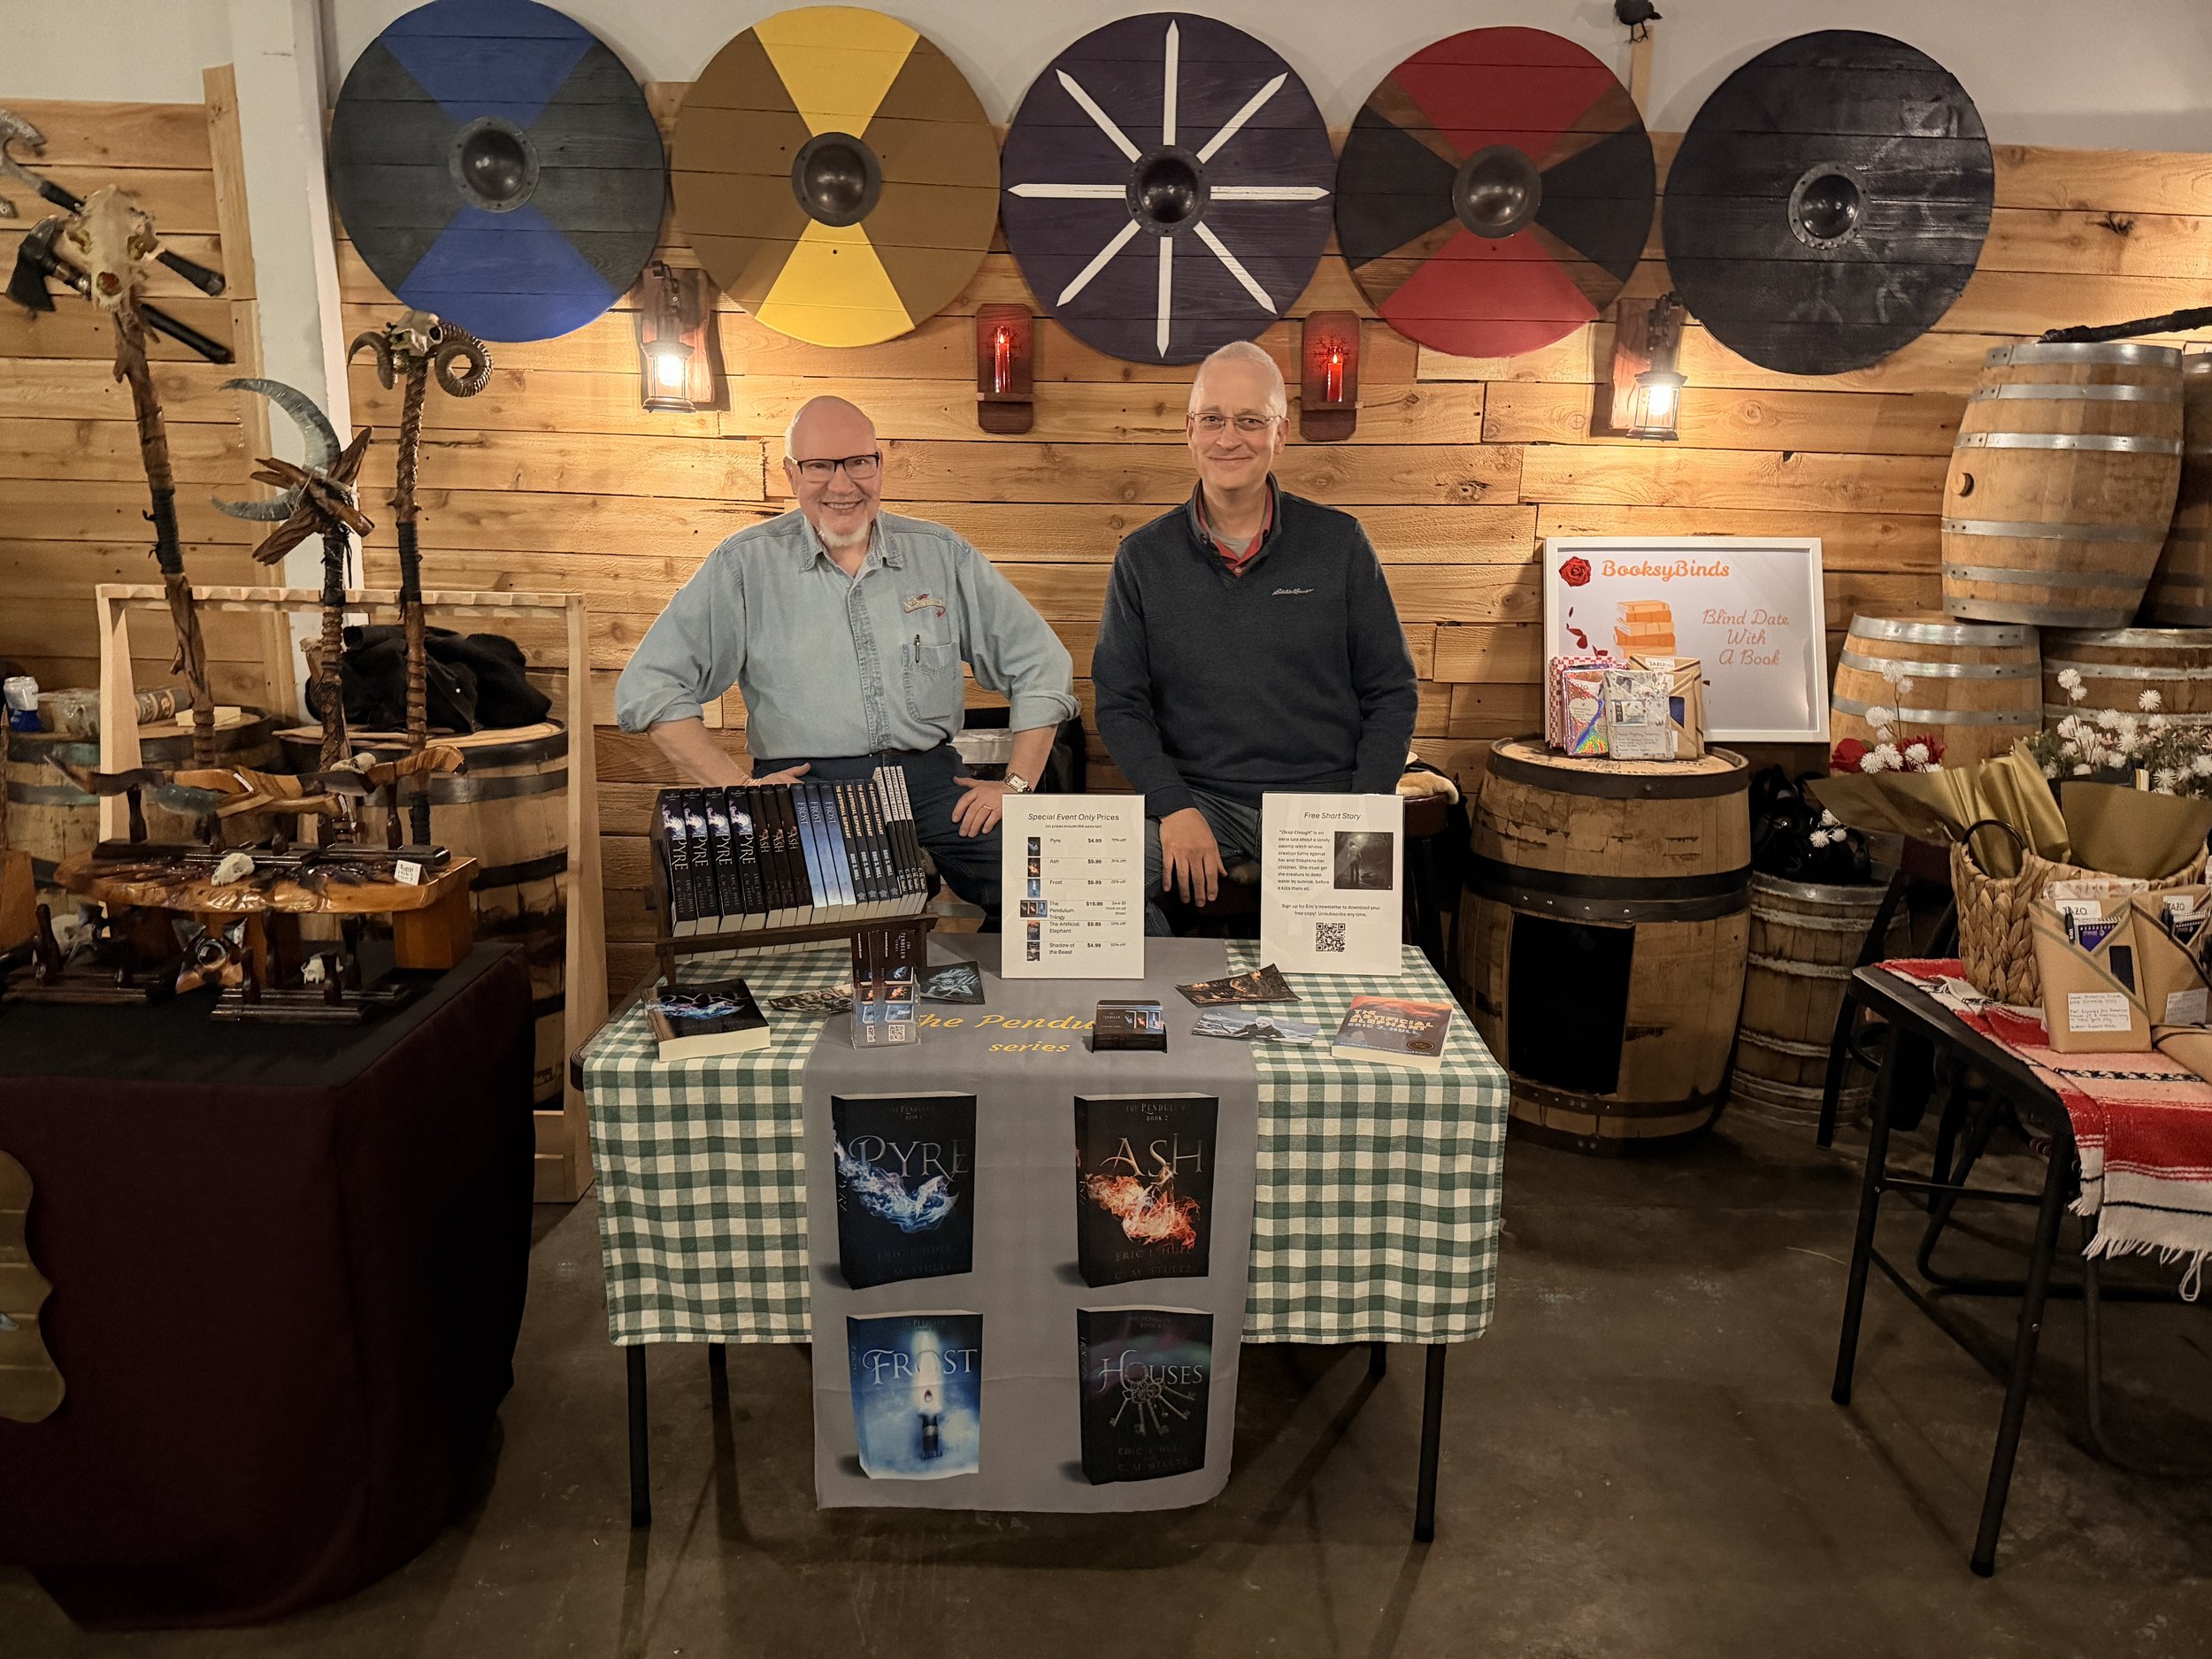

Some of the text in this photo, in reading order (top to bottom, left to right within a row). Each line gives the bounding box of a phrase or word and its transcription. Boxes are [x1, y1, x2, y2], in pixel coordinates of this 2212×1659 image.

[1602, 559, 1730, 582] BooksyBinds
[1702, 608, 1789, 625] Blind Date
[1727, 629, 1766, 645] With
[1719, 649, 1780, 666] A Book
[797, 802, 808, 825] FROST
[810, 801, 821, 823] FROST
[825, 801, 836, 823] FROST
[1028, 814, 1055, 823] Special
[1342, 812, 1361, 821] Story
[715, 833, 732, 865] PYRE
[739, 832, 756, 864] PYRE
[759, 834, 770, 853] ASH
[773, 835, 784, 853] ASH
[788, 831, 799, 849] ASH
[671, 837, 688, 870] PYRE
[692, 835, 708, 867] PYRE
[975, 1014, 1095, 1030] Pendu
[1350, 1018, 1427, 1031] ELEPHANT
[1351, 1014, 1434, 1028] ARTIFICIAL
[988, 1041, 1071, 1053] series
[849, 1135, 970, 1181] PYRE
[1100, 1133, 1203, 1177] ASH
[862, 1349, 978, 1385] FROST
[1098, 1350, 1203, 1393] HOUSES
